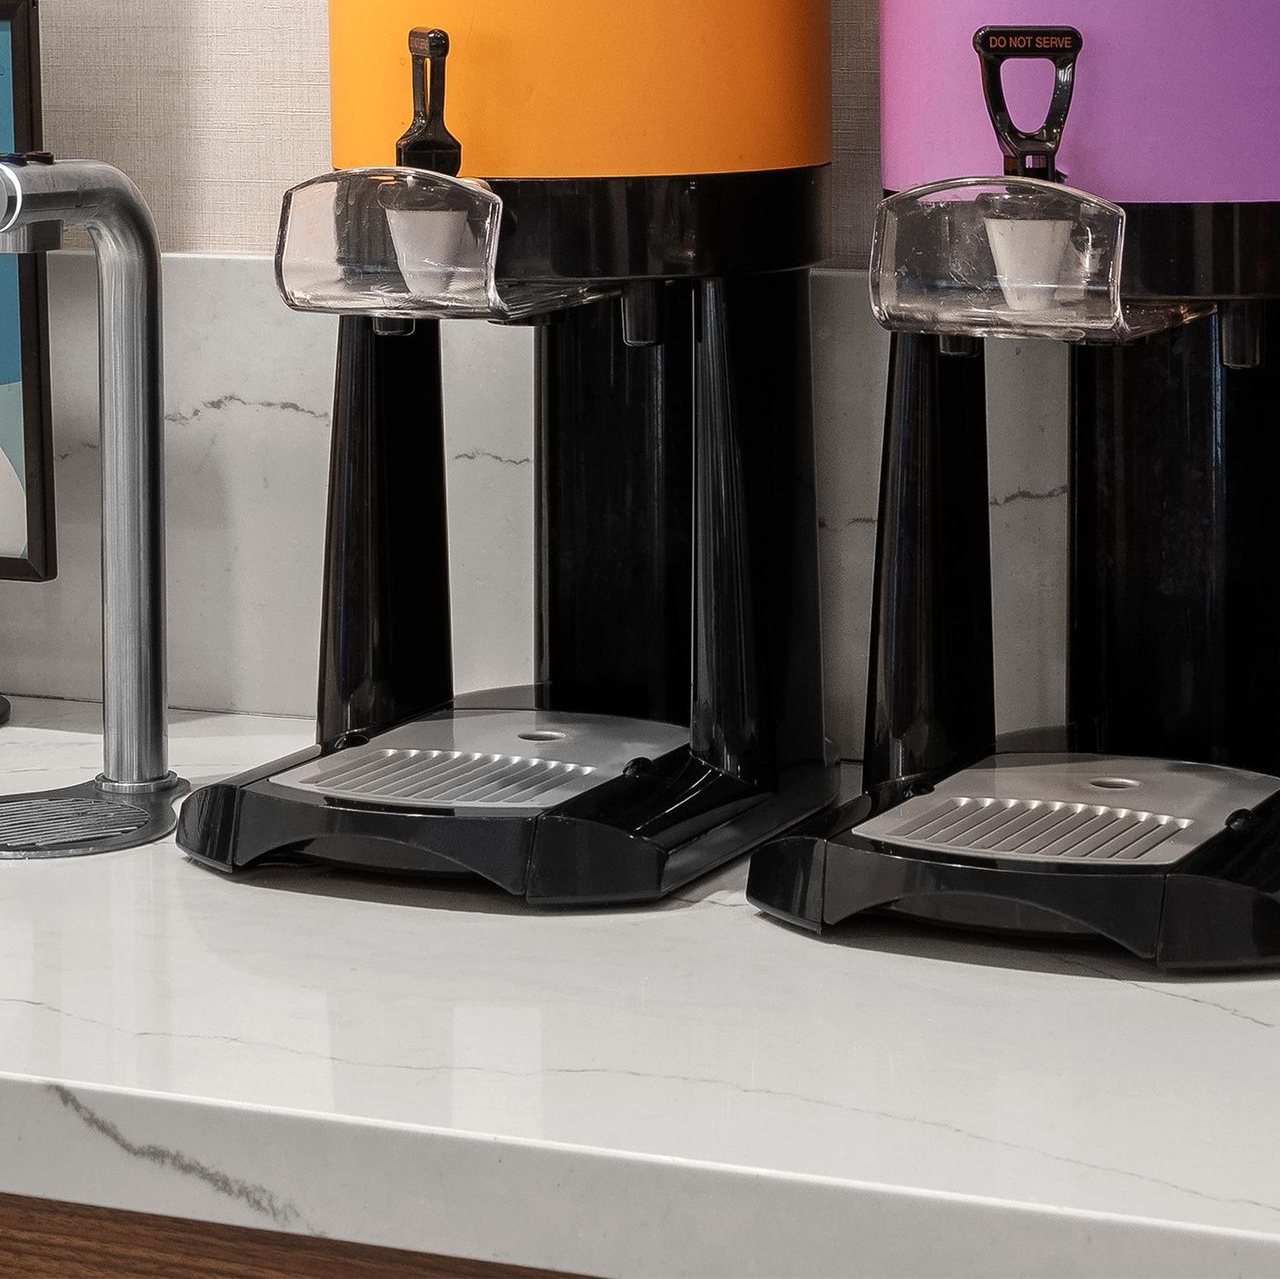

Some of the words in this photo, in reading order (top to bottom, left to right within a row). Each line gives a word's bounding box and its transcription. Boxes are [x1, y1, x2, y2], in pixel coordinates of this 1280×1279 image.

[989, 36, 1007, 49] DO
[1009, 36, 1033, 49] NOT
[1035, 36, 1072, 49] SERVE
